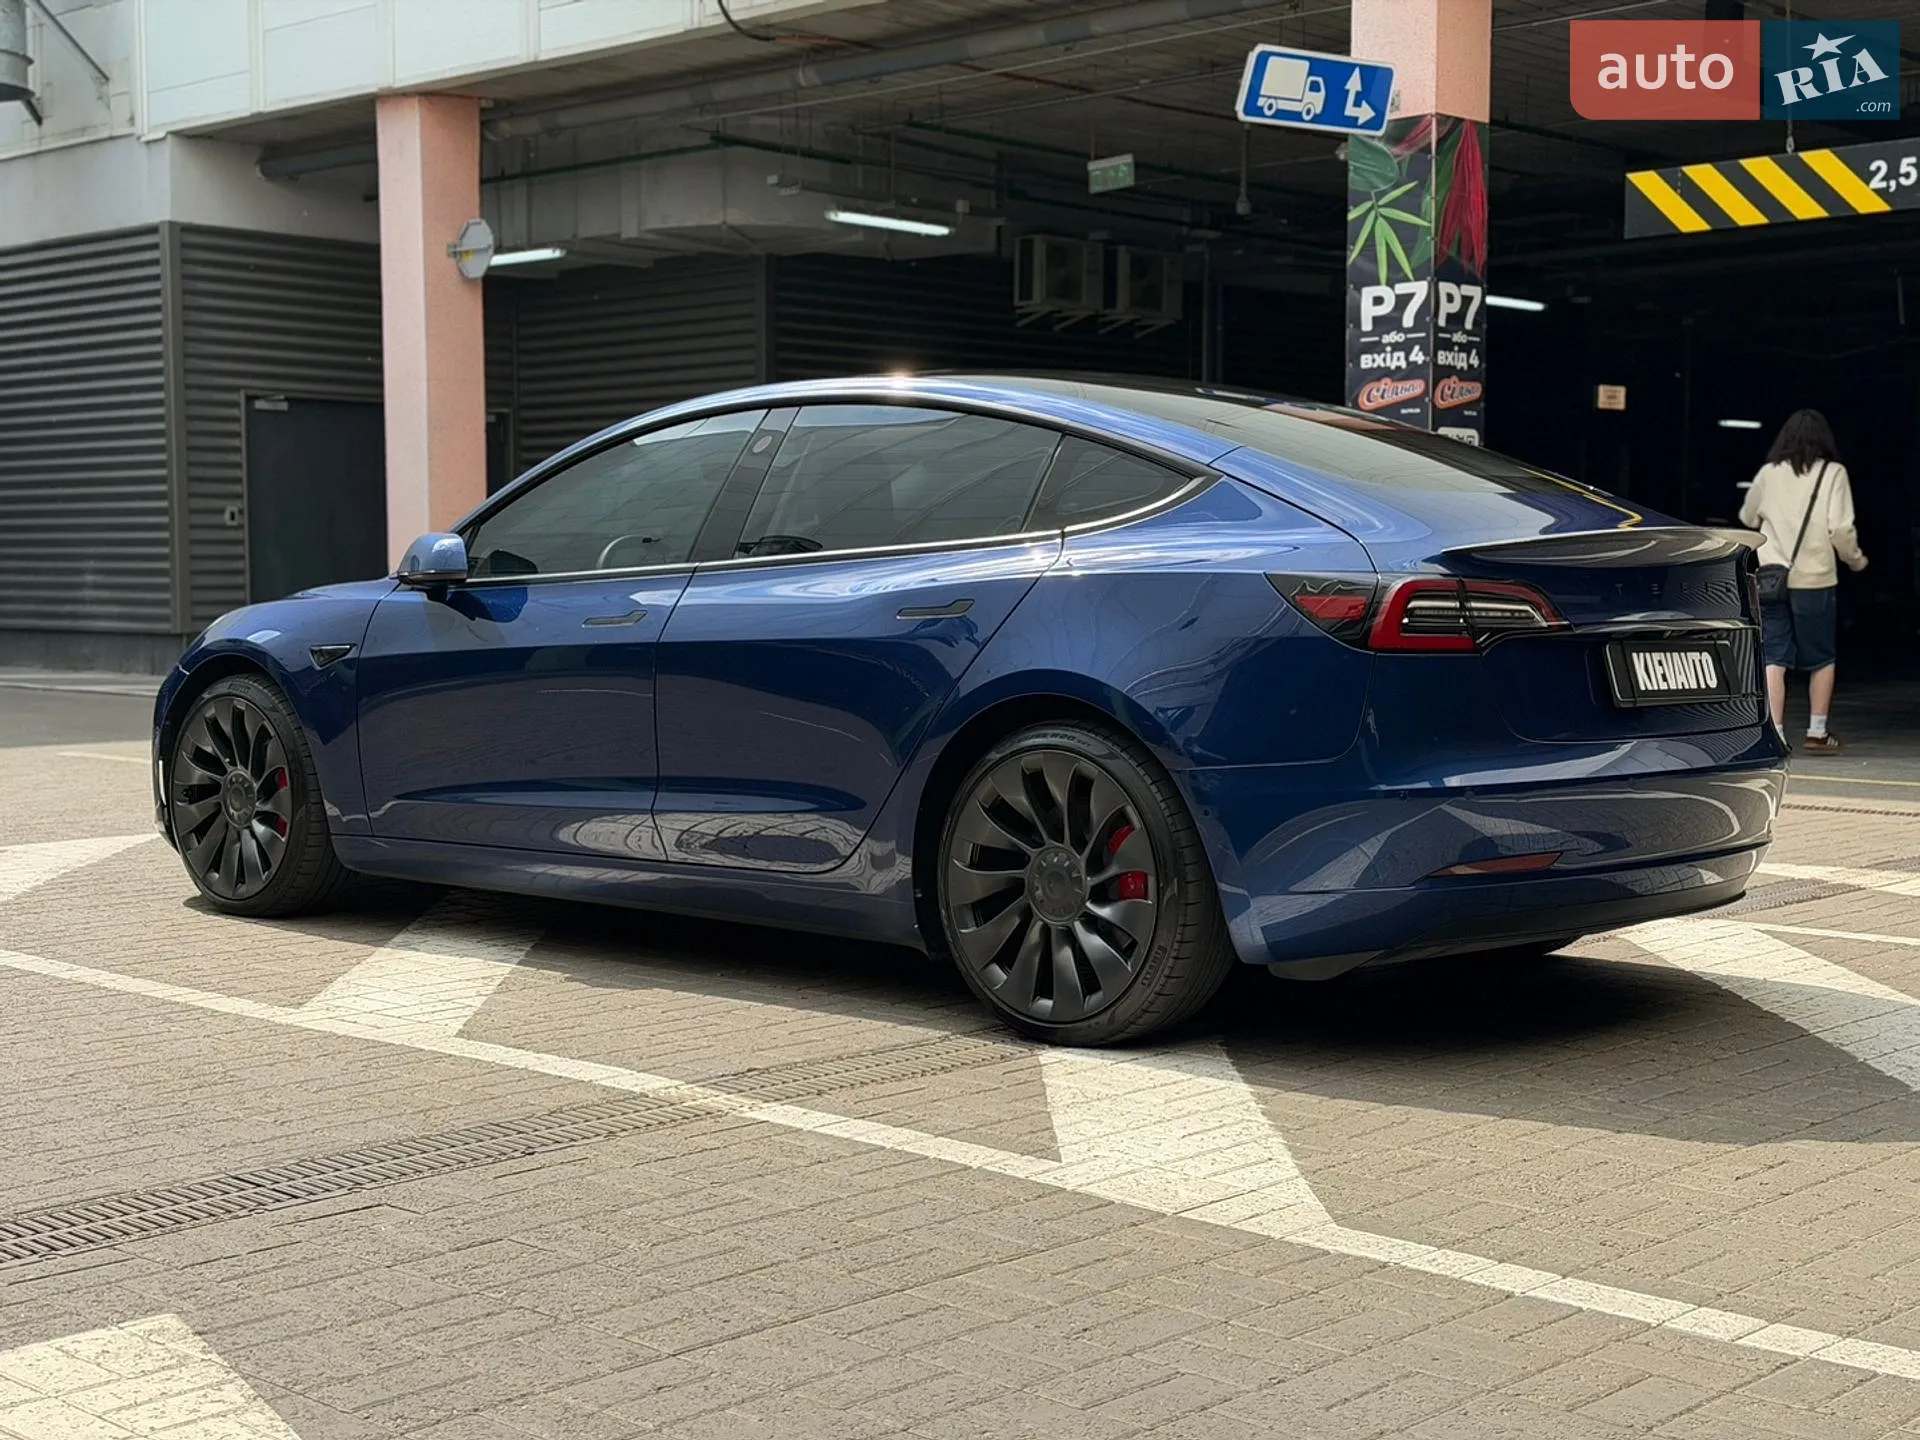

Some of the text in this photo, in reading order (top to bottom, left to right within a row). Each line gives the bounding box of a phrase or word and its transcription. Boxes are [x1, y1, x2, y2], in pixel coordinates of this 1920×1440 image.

[1869, 156, 1918, 192] 2,5
[1361, 281, 1429, 332] P7
[1438, 281, 1482, 330] P7
[1381, 331, 1406, 344] або
[1452, 331, 1468, 344] або
[1360, 345, 1425, 370] вхід 4
[1437, 345, 1480, 371] вхід 4
